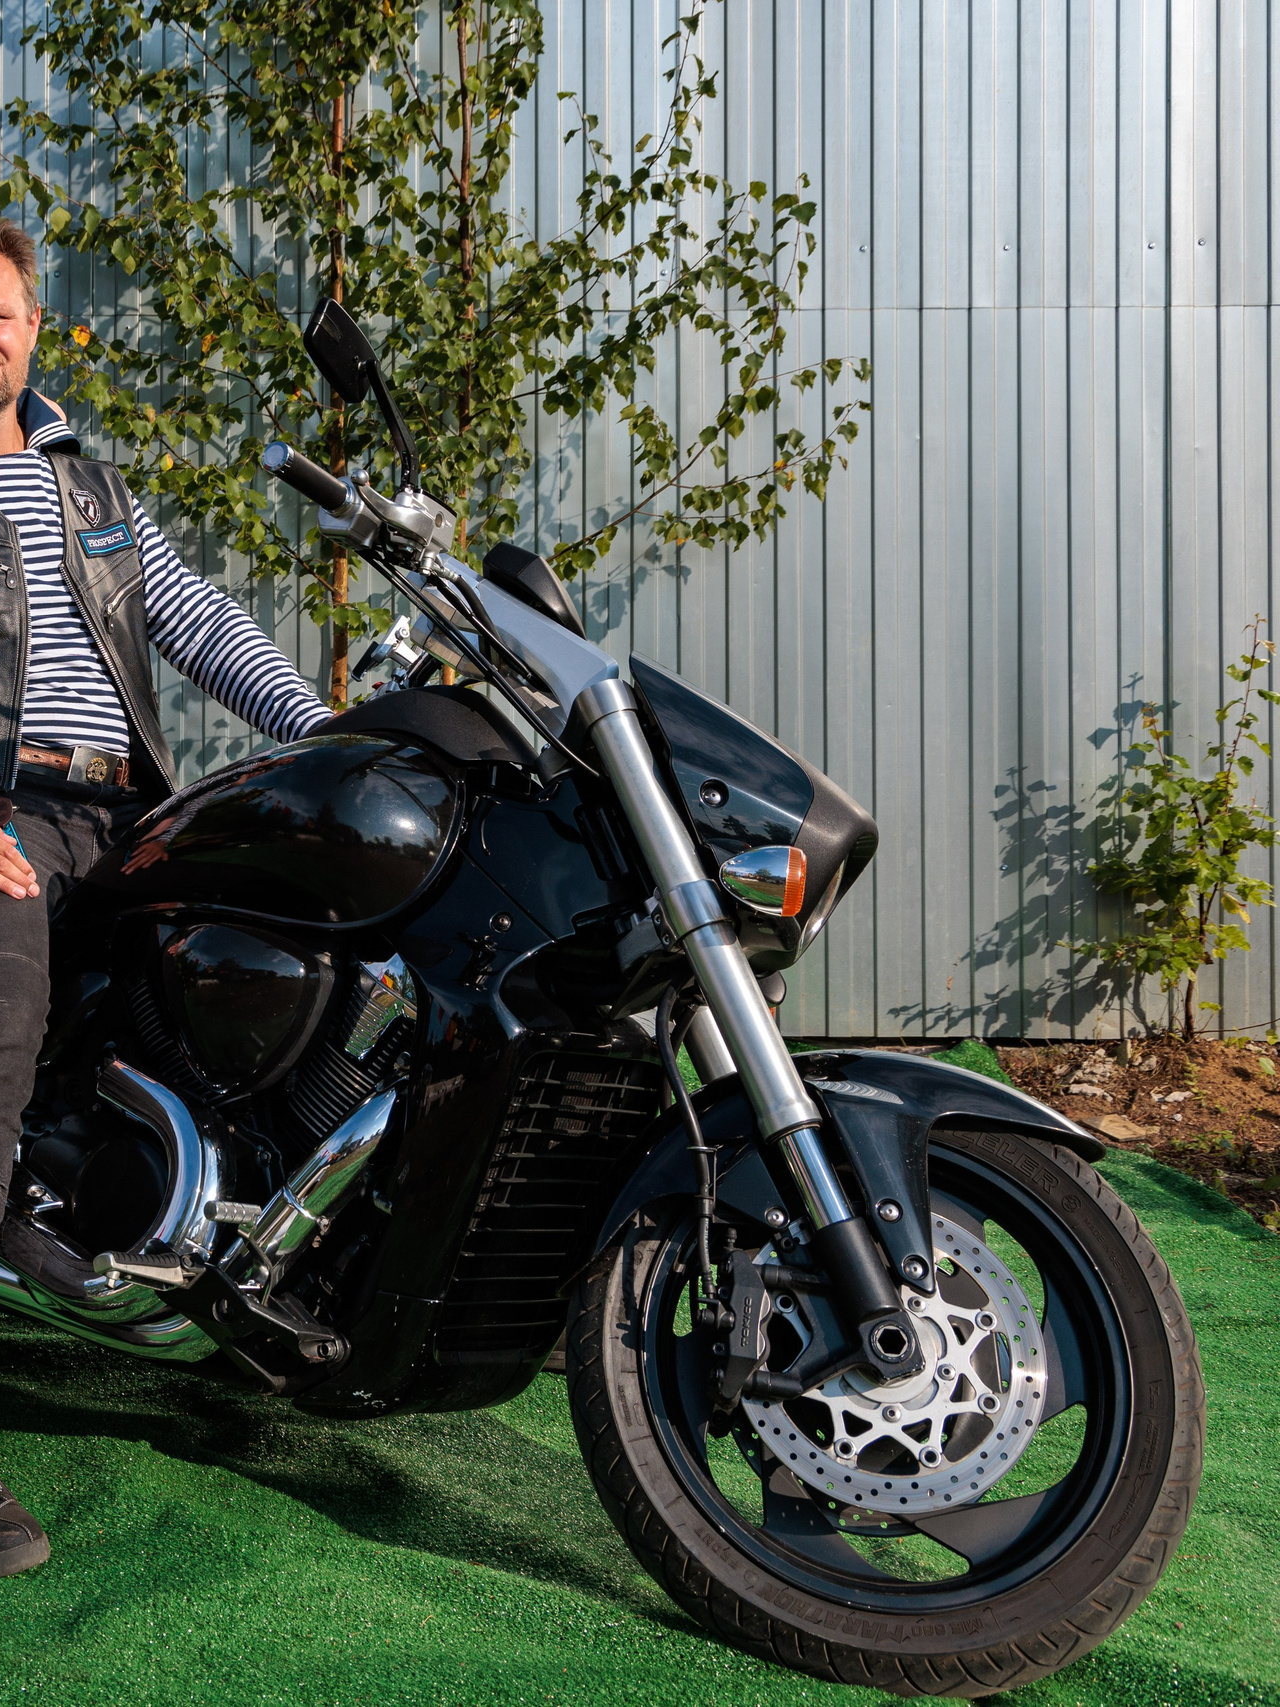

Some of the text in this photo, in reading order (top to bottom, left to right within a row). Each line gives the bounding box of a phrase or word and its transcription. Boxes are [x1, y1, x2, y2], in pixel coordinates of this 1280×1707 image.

[87, 531, 125, 548] PROSPECT
[740, 1296, 752, 1347] TOKICO
[757, 1581, 903, 1643] MARATHON
